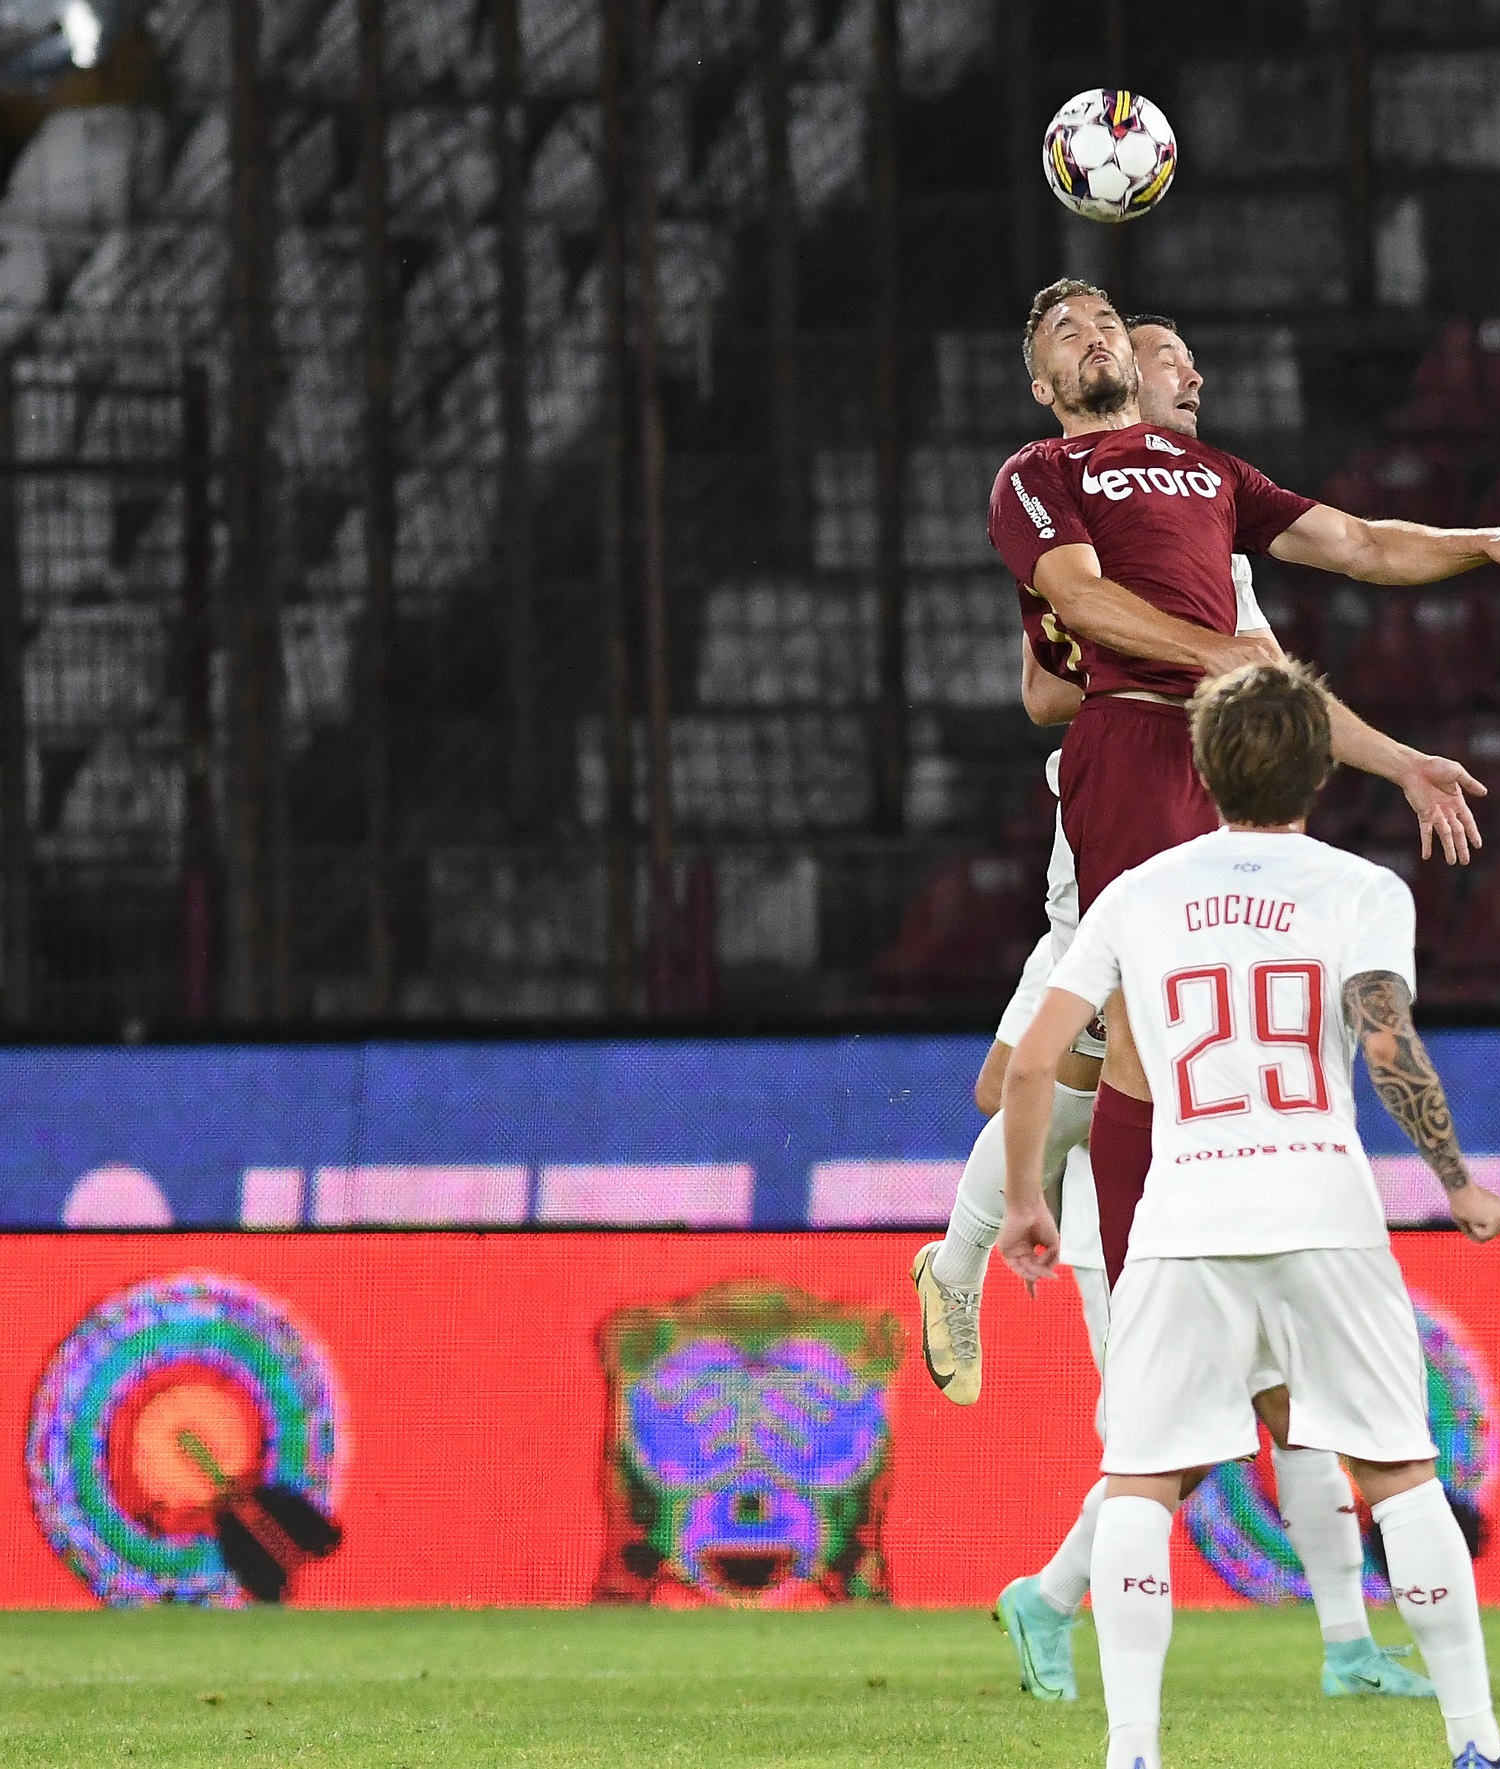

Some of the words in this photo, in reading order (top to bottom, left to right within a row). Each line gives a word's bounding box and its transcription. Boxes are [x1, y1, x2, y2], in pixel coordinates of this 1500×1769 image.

[1010, 472, 1046, 529] POKERSTARS
[1031, 496, 1052, 525] CASINO
[1185, 894, 1296, 933] COCIUC
[1161, 958, 1332, 1126] 29
[1175, 1143, 1278, 1165] GOLD'S
[1288, 1141, 1349, 1155] GYM
